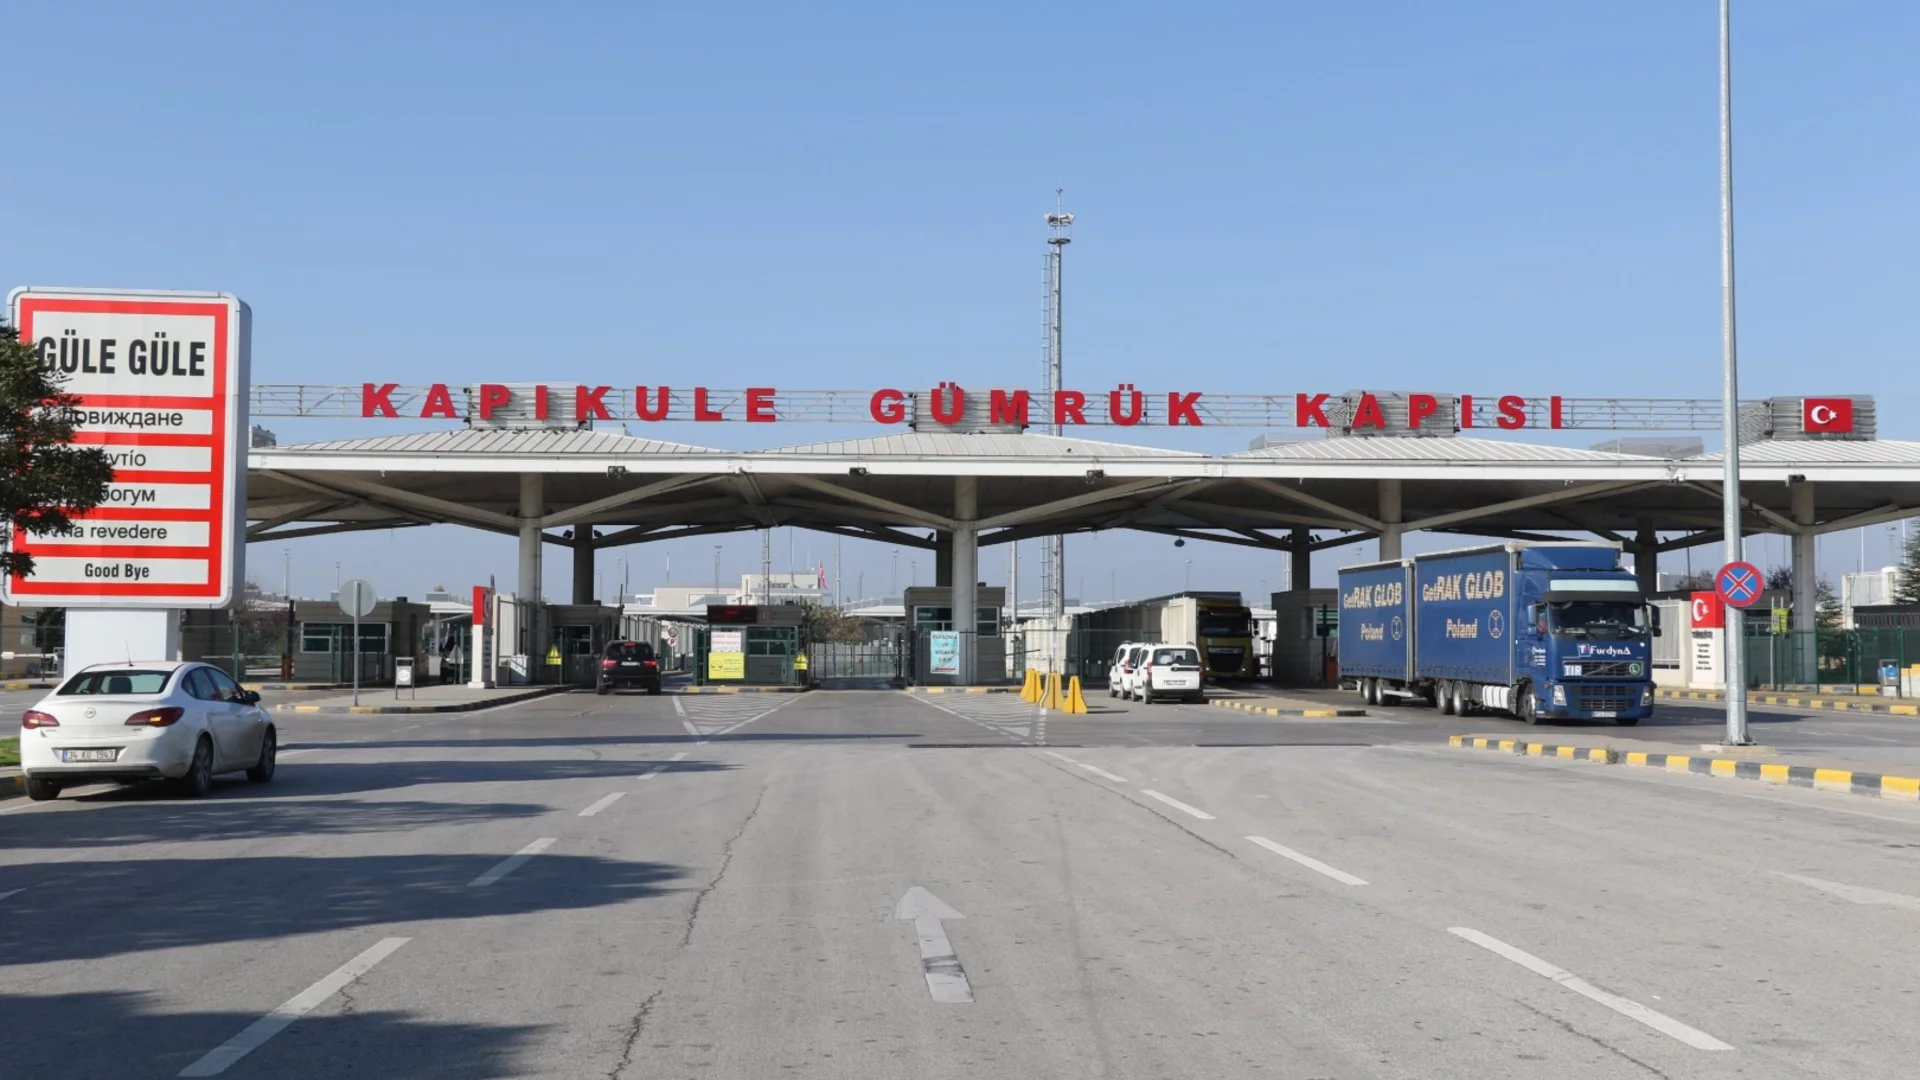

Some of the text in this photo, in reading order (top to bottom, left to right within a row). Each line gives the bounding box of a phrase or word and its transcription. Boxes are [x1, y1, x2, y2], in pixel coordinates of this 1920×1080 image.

[38, 329, 206, 377] GÜLE GÜLE
[362, 382, 1563, 430] KAPIKULE GÜMRÜK KAPISI
[90, 524, 167, 539] revedere
[84, 563, 150, 581] Good Bye
[1374, 582, 1402, 607] GLOB
[1465, 570, 1504, 601] GLOB
[1361, 623, 1384, 641] Poland
[1446, 618, 1478, 639] Poland
[1563, 664, 1583, 677] TIR
